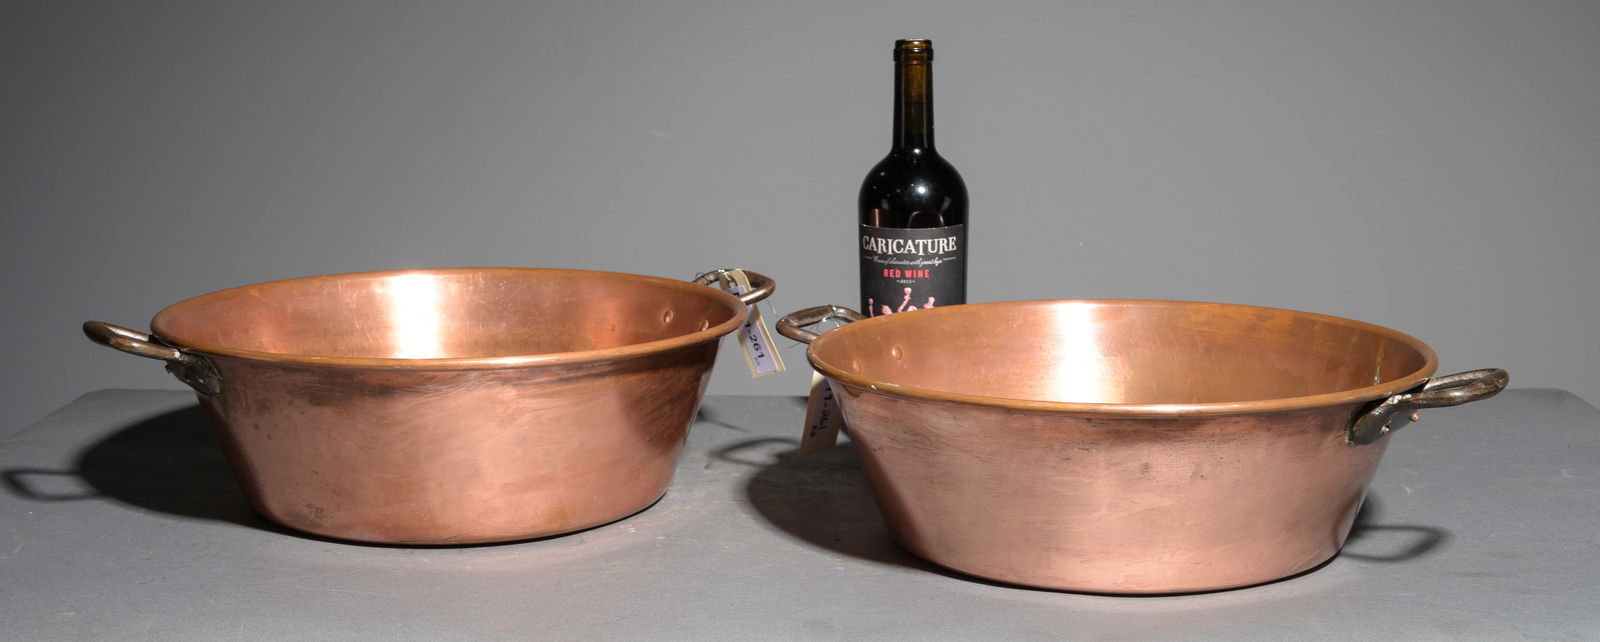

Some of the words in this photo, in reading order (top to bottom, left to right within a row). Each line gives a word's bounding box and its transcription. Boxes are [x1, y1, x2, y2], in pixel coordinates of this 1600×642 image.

[863, 236, 957, 256] CARICATURE
[883, 268, 901, 278] RED
[905, 269, 930, 279] WINE
